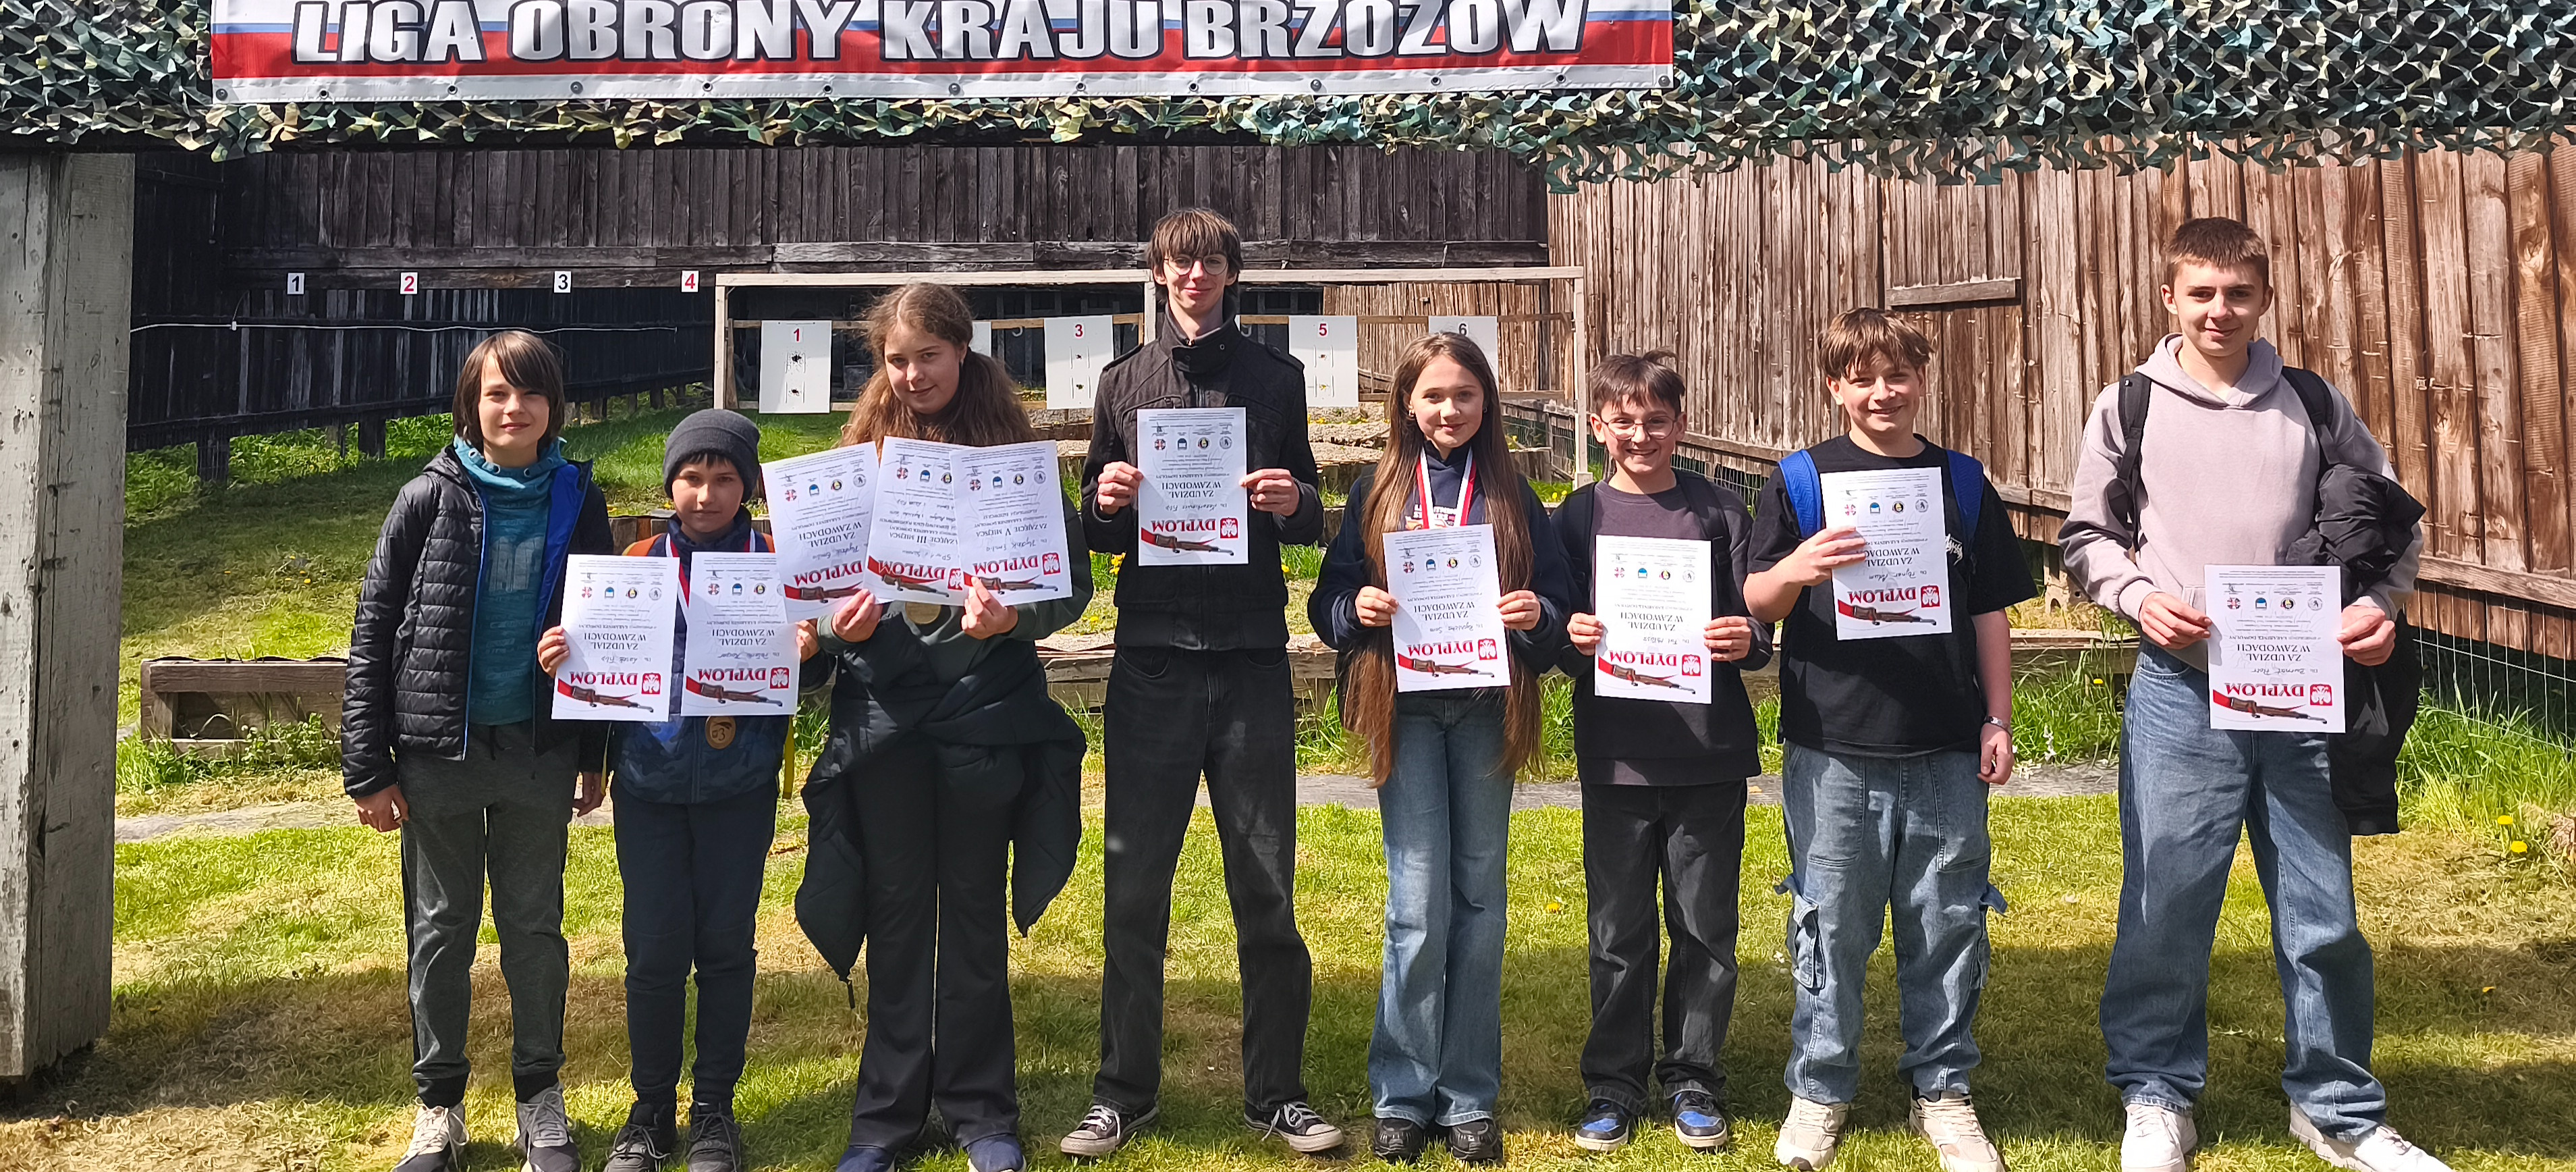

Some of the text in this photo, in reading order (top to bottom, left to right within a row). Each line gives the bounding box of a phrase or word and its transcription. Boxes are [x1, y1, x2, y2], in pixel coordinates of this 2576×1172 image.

[291, 0, 487, 64] LIGA
[504, 0, 860, 63] OBRONY
[878, 0, 1166, 61] KRAJU
[291, 275, 301, 292] 1
[404, 275, 415, 292] 2
[557, 274, 569, 290] 3
[684, 273, 696, 289] 4
[793, 329, 800, 342] 1
[1074, 323, 1084, 338] 3
[1319, 323, 1327, 336] 5
[1458, 323, 1467, 336] 6
[1162, 481, 1211, 489] ZAWODACH
[1006, 528, 1011, 536] V
[1151, 518, 1215, 533] DYPLOM
[844, 531, 855, 540] ZA
[916, 535, 927, 543] III
[1863, 548, 1909, 557] ZAWODAC
[878, 560, 946, 580] DYPLOM
[972, 555, 1039, 575] DYPLOM
[794, 560, 862, 586] DYPLOM
[1848, 587, 1917, 604] DYPLOM
[1406, 640, 1473, 656] DYPLOM
[1609, 650, 1677, 666] DYPLOM
[570, 672, 638, 685] DYPLOM
[698, 668, 766, 681] DYPLOM
[2224, 683, 2305, 697] DYPLOM
